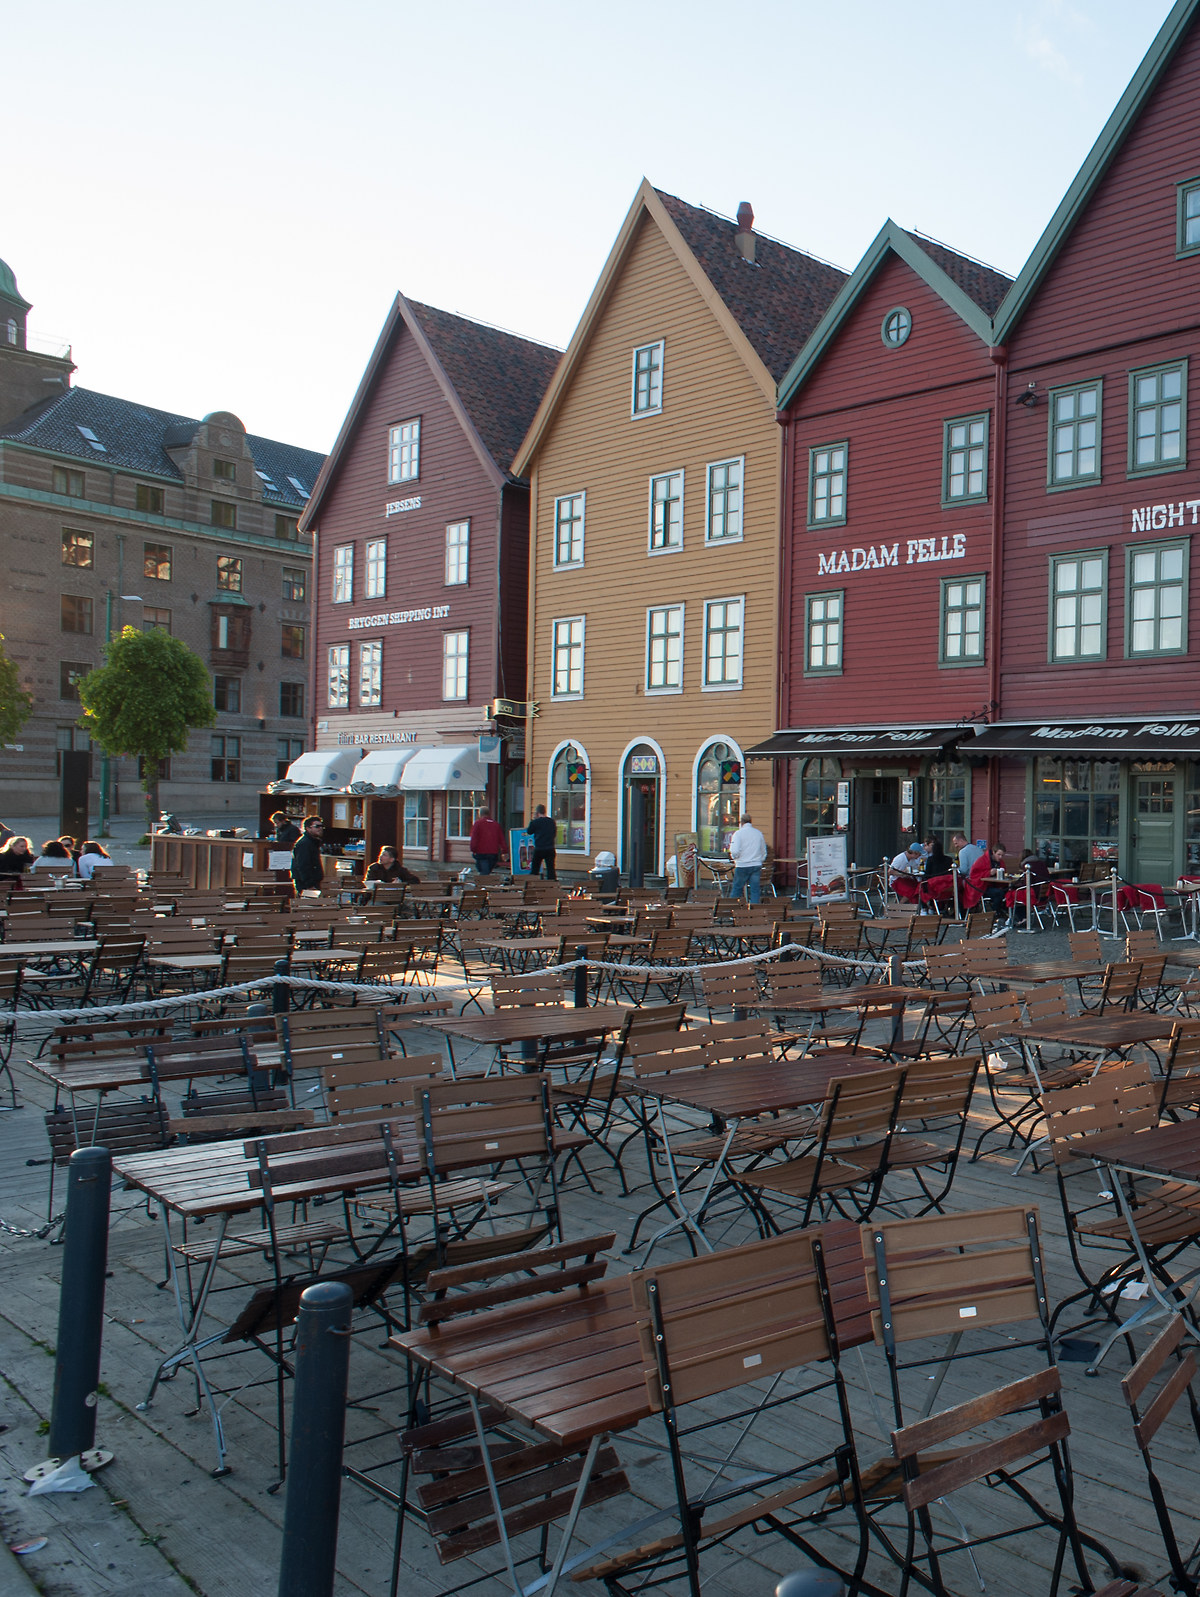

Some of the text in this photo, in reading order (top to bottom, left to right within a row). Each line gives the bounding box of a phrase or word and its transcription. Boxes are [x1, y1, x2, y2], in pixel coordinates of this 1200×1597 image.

[818, 533, 967, 575] MADAM FELLE
[348, 605, 450, 629] BRYGGEN SHIPPING INT
[354, 734, 369, 744] BAR
[369, 732, 417, 744] RESTAURANT
[797, 731, 932, 743] Madam Felle
[1030, 723, 1200, 739] Madam Felle
